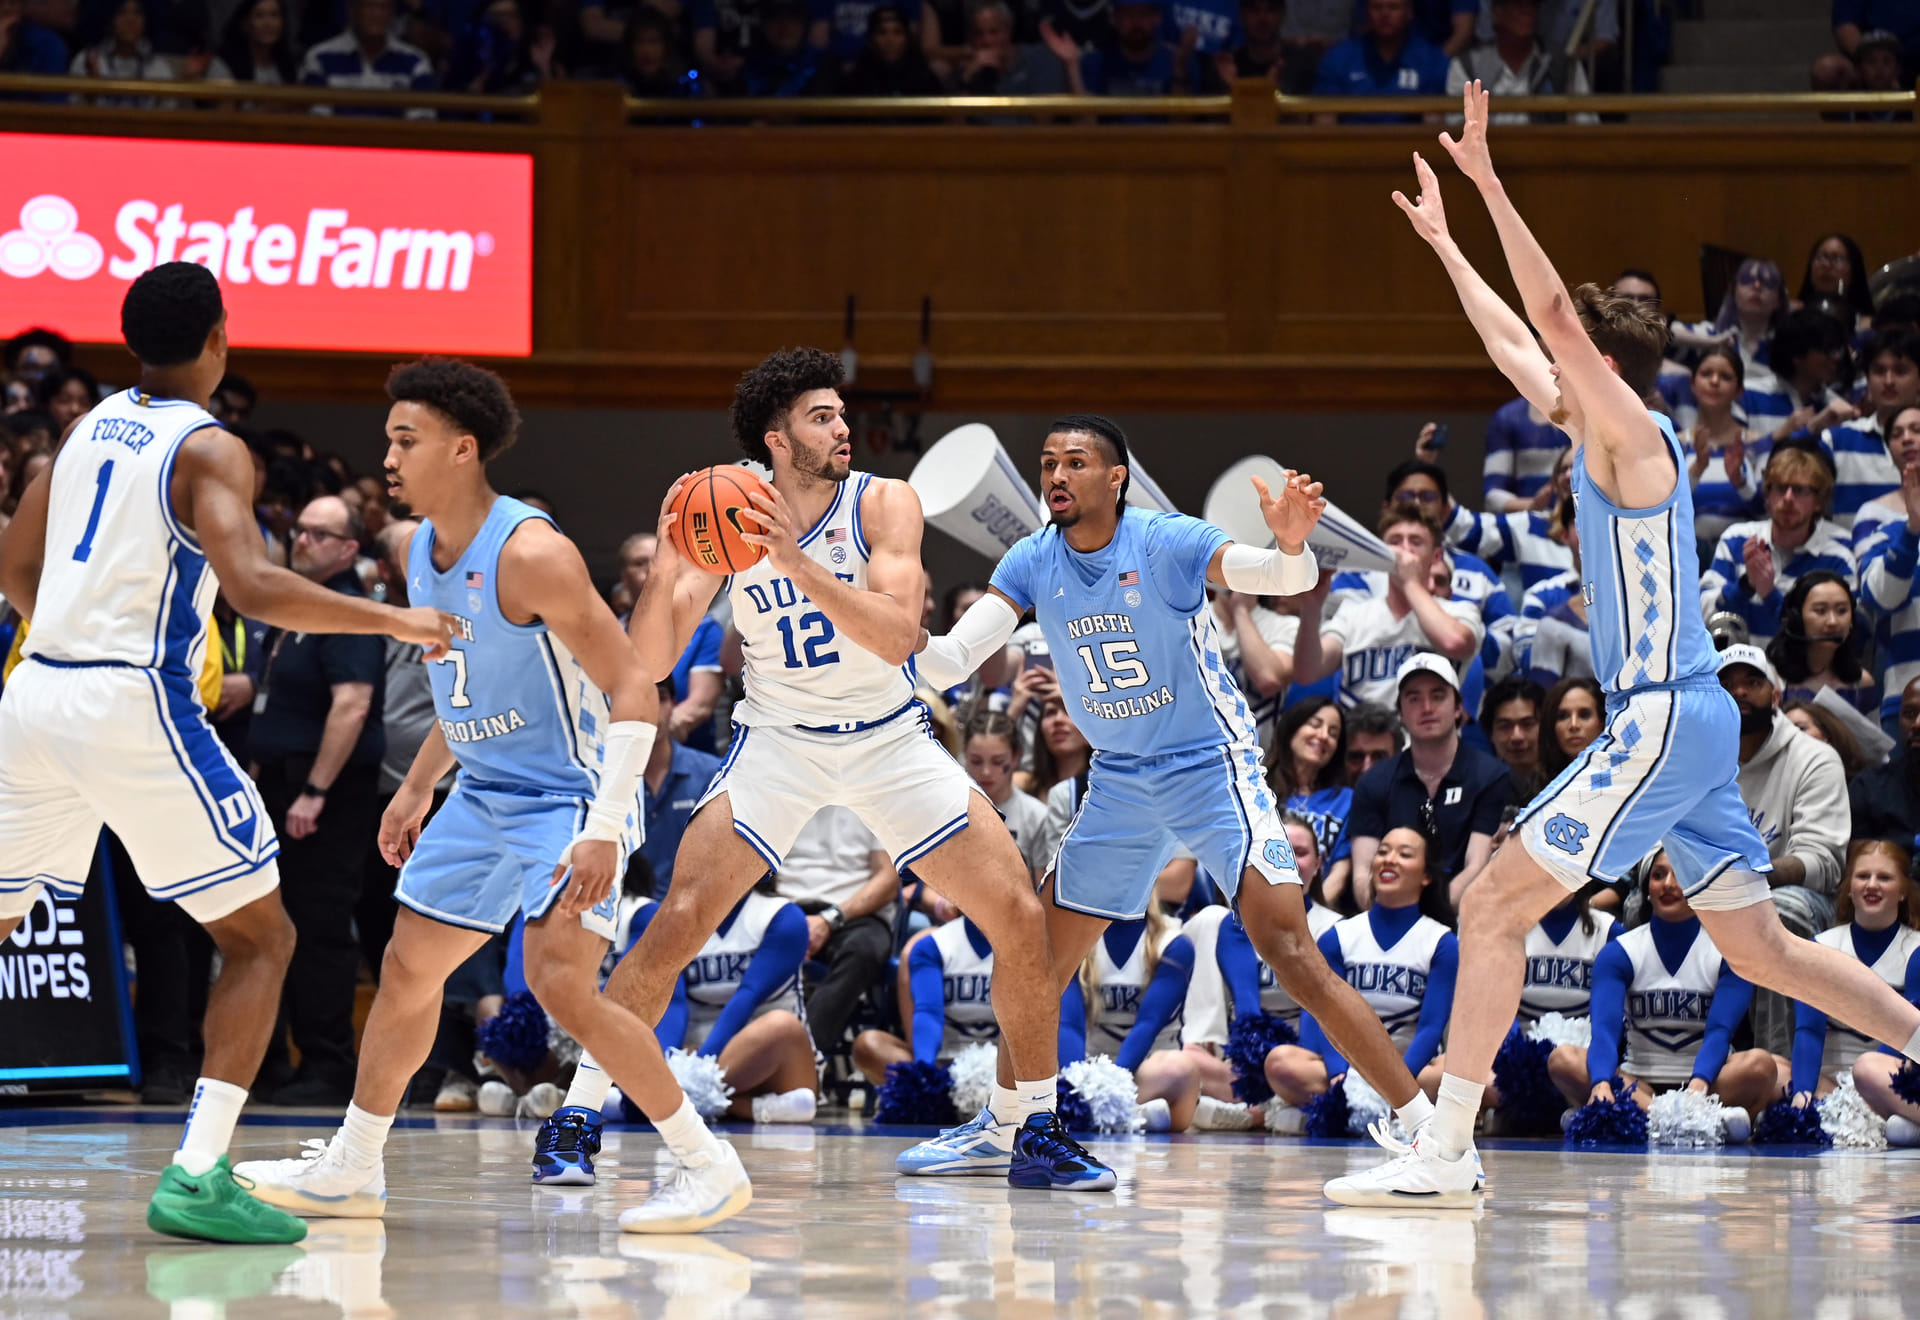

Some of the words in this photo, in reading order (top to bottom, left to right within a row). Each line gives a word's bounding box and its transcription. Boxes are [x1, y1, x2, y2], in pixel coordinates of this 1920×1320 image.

[91, 417, 155, 455] FOSTER
[72, 459, 115, 563] 1
[776, 611, 841, 669] 12
[1067, 614, 1135, 641] NORTH
[436, 649, 472, 708] 7
[1077, 639, 1150, 693] 15
[1081, 686, 1175, 720] CAROLINA
[218, 790, 253, 829] D
